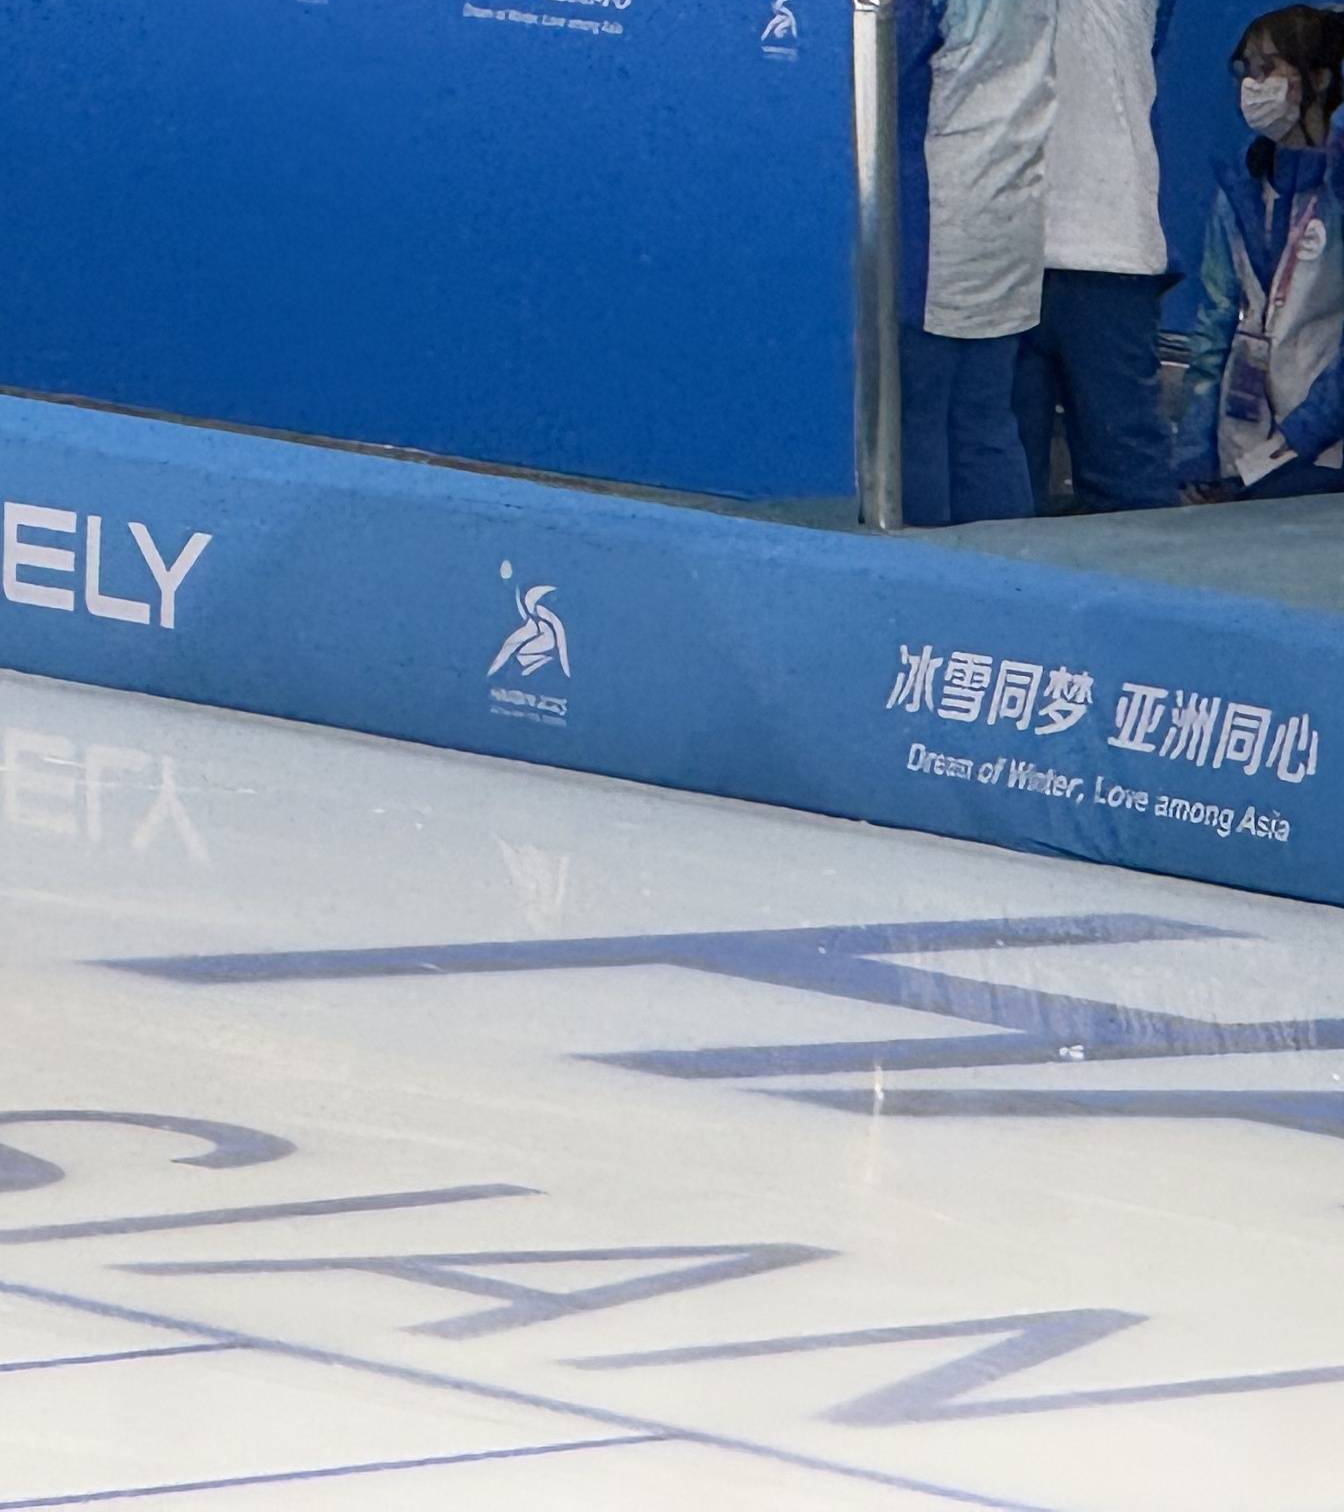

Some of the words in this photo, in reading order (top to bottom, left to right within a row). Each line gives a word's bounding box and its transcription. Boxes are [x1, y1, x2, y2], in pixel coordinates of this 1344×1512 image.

[886, 643, 1094, 736] 冰雪同梦
[1107, 681, 1319, 784] 亚洲同心
[907, 742, 973, 781] Dream
[977, 756, 1008, 784] of
[1094, 775, 1150, 813] Love
[1154, 792, 1235, 838] among
[1236, 805, 1292, 843] Asia
